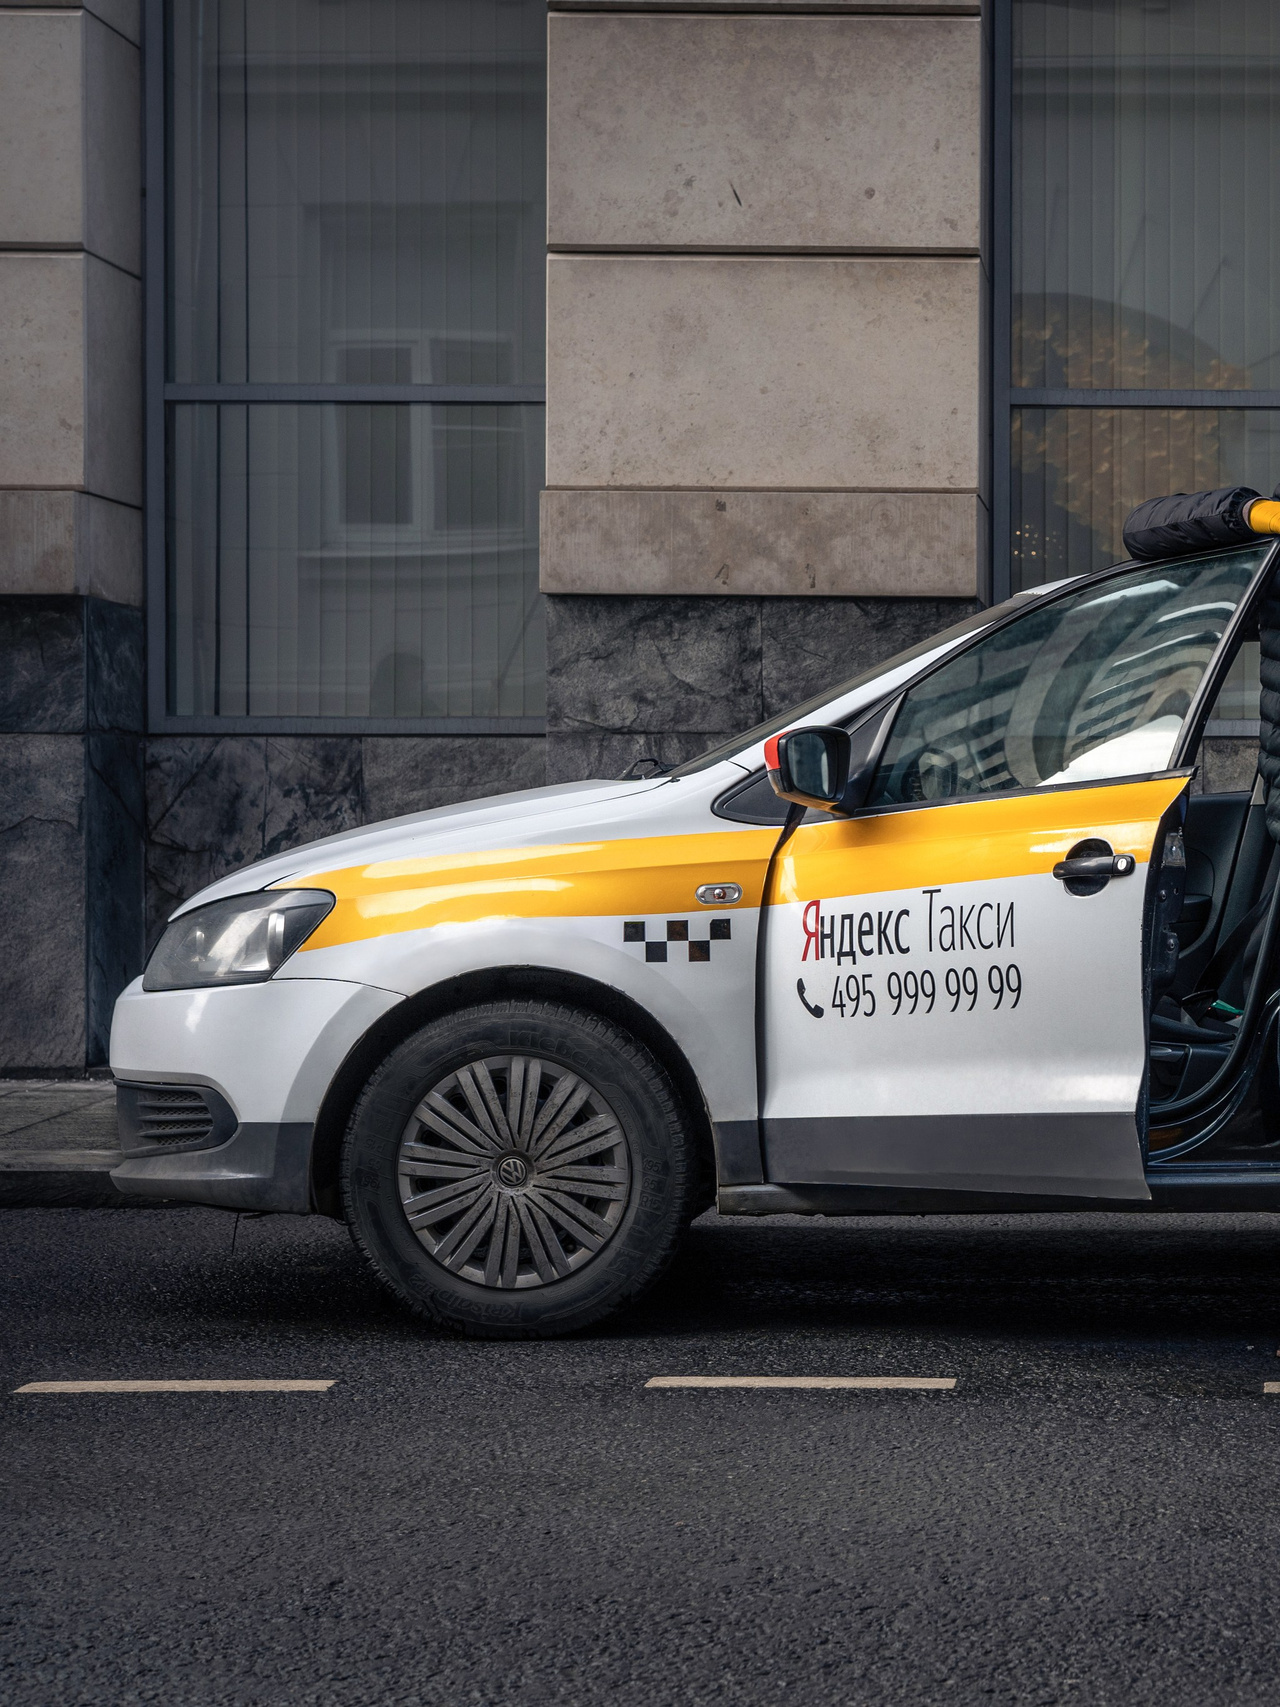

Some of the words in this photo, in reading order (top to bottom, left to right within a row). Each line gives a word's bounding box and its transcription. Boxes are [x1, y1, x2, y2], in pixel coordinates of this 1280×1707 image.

[801, 899, 911, 966] Яндекс
[922, 888, 1015, 952] Такси
[831, 973, 876, 1018] 495
[887, 969, 936, 1016] 999
[945, 966, 979, 1013] 99
[987, 963, 1022, 1010] 99
[508, 1030, 602, 1073] Kleber
